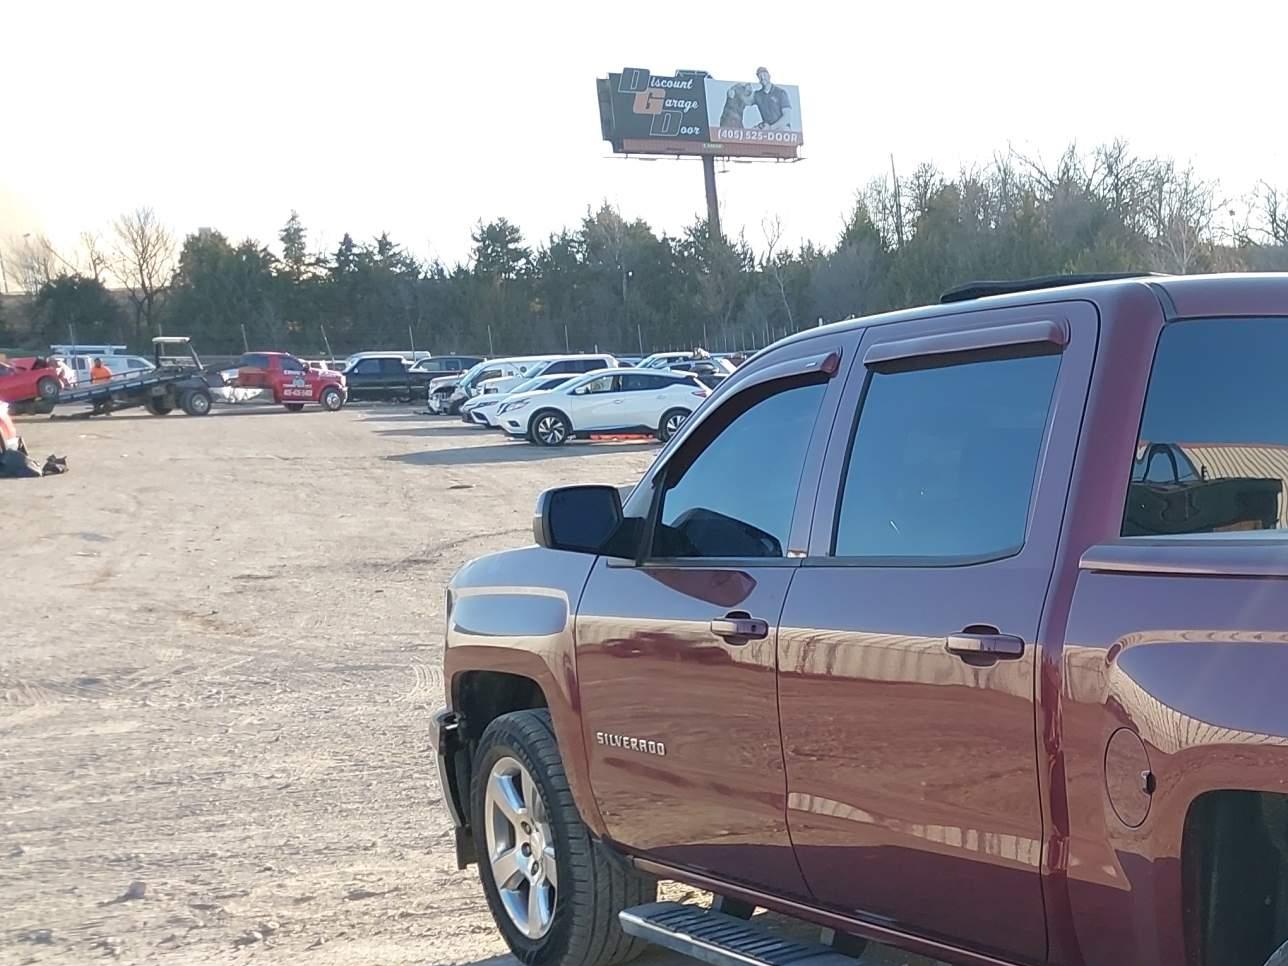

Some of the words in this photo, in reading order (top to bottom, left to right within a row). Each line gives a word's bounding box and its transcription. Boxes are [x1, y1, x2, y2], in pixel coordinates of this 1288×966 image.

[618, 67, 694, 93] Discount
[633, 87, 699, 114] Garage
[649, 109, 701, 137] Door
[717, 129, 744, 141] (405)
[745, 130, 798, 143] 525-DOOR
[596, 731, 667, 756] SILVERADO
